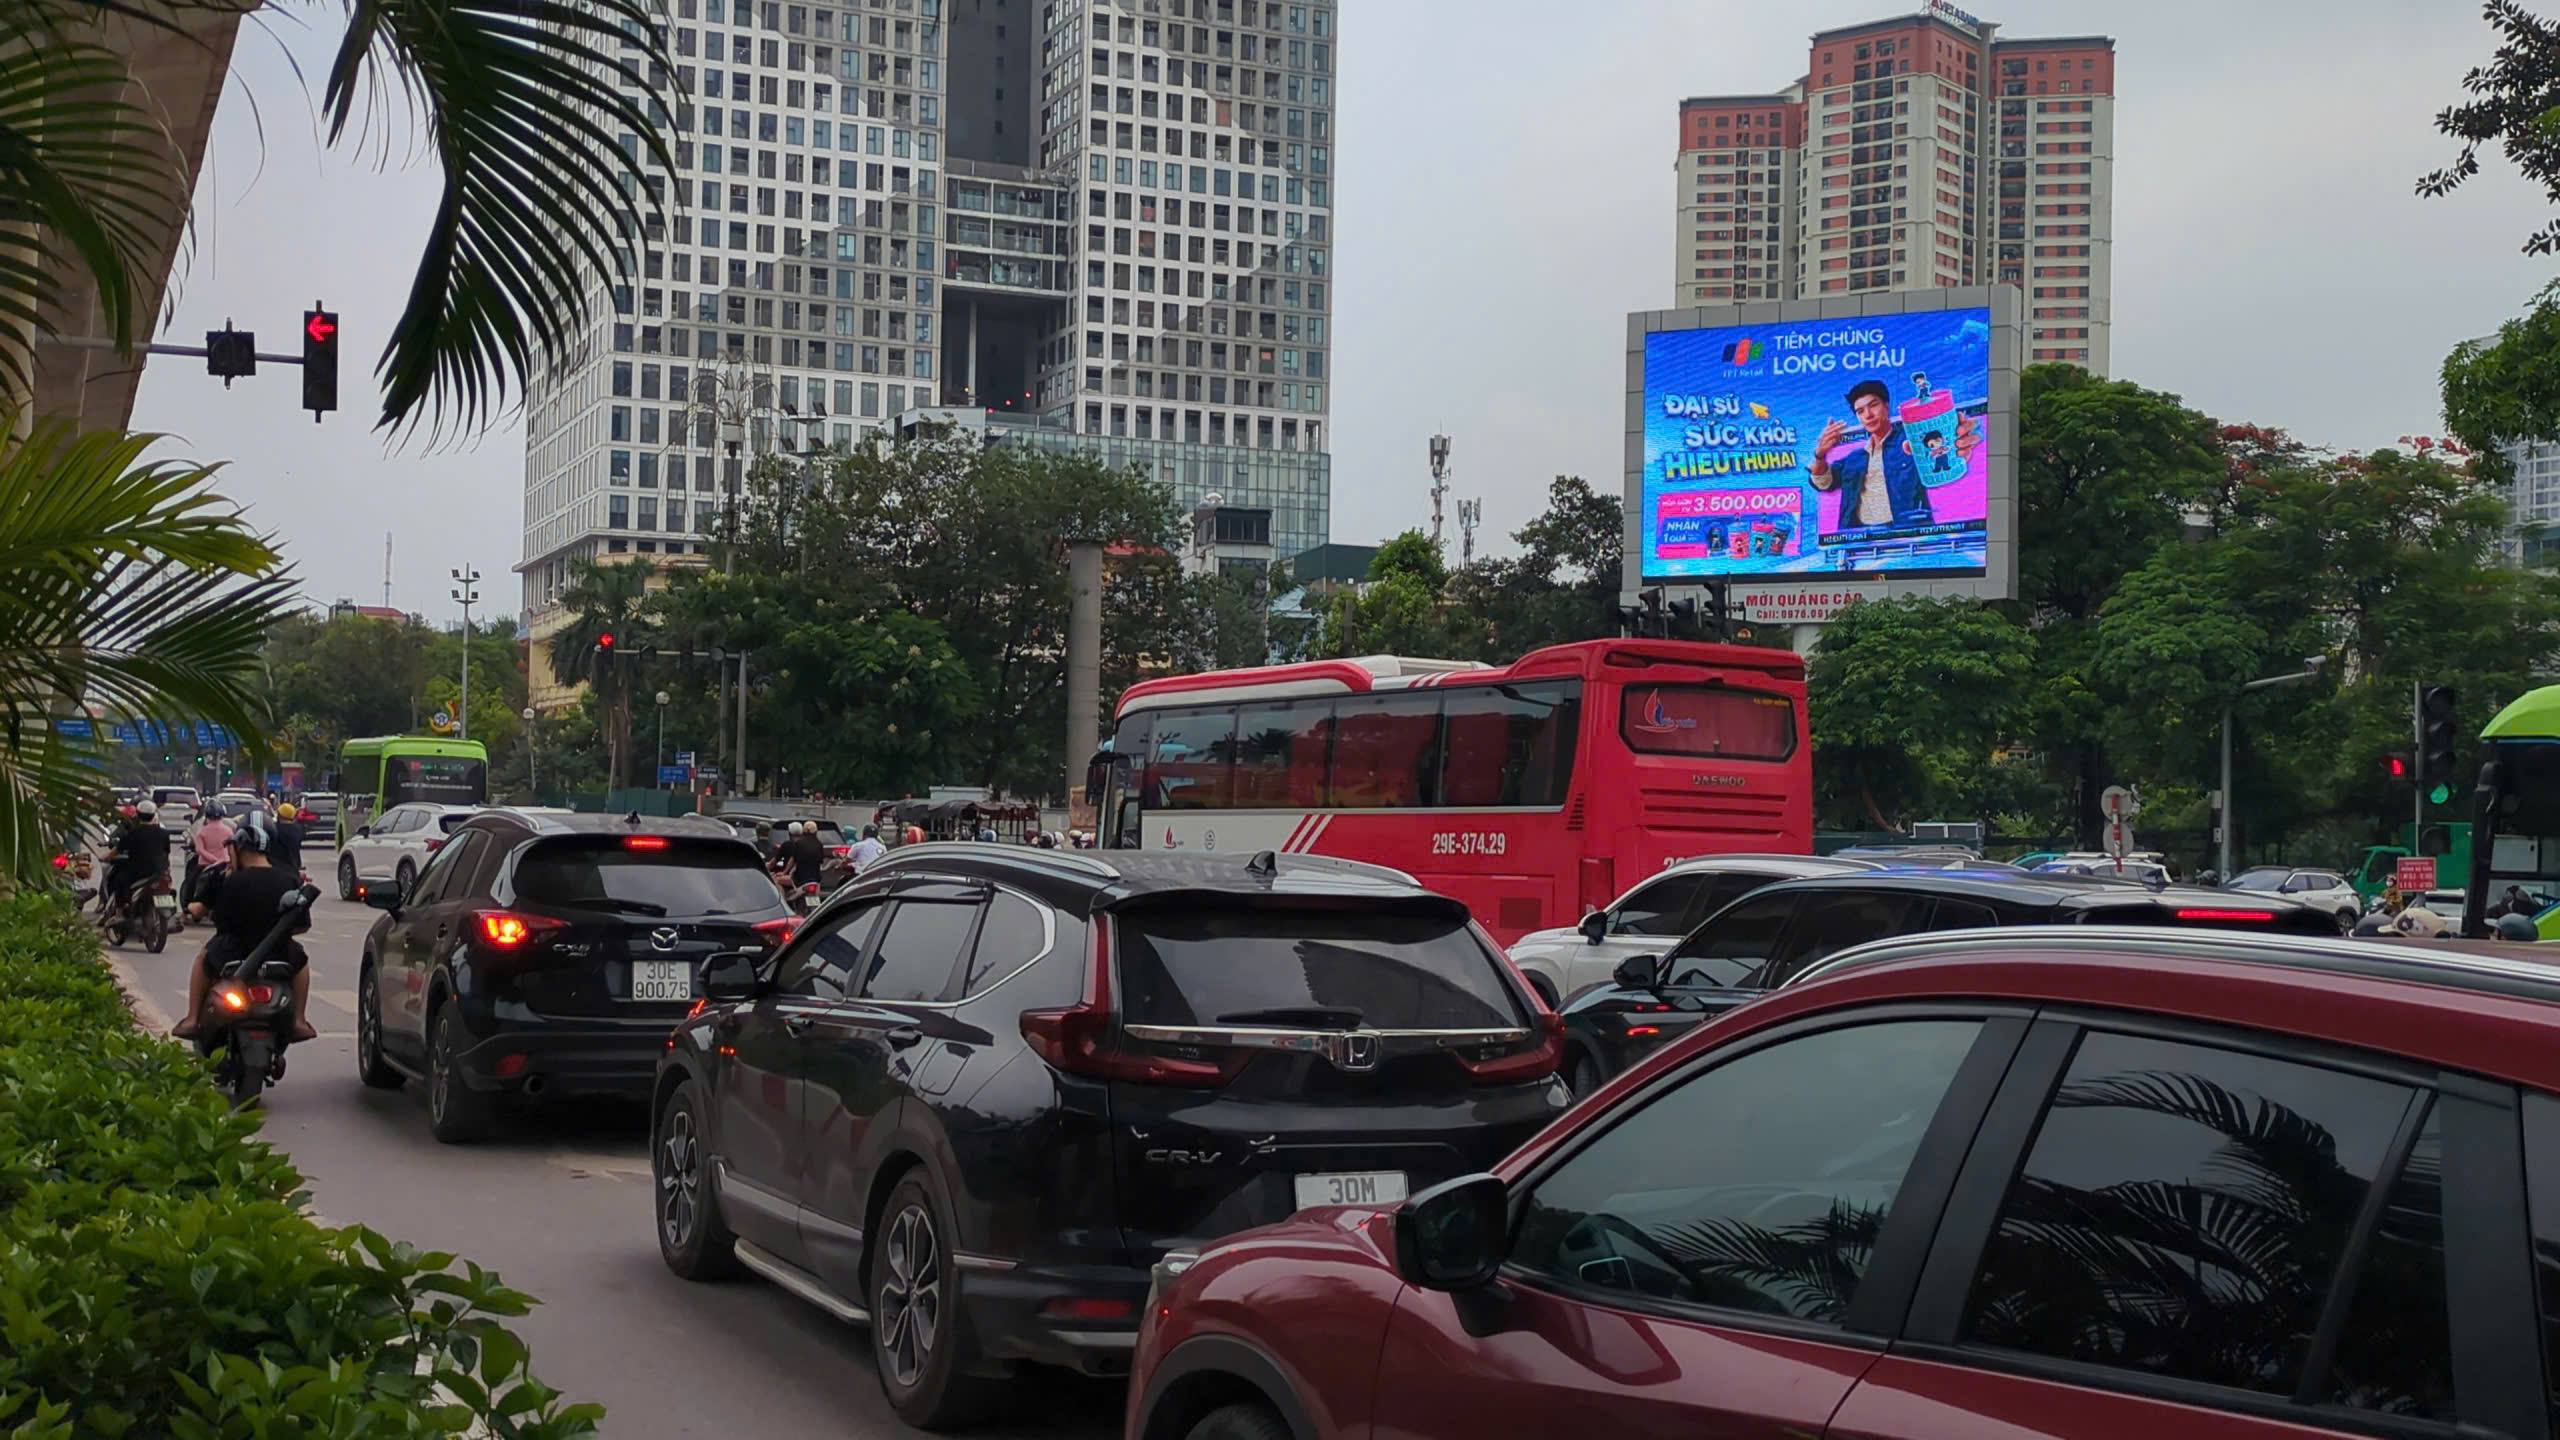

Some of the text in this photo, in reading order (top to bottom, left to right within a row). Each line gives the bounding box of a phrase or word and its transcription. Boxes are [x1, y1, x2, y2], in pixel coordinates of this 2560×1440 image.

[1774, 331, 1813, 349] TIÊM
[1773, 345, 1906, 375] LONG CHÂU
[1664, 394, 1709, 419] ĐẠI
[1685, 420, 1740, 447] SỨC
[1664, 450, 1797, 478] HIEUTHUHAI
[1692, 774, 1746, 787] DAEWOO
[1432, 832, 1505, 854] 29E-374.29
[647, 962, 677, 980] 30E
[635, 981, 689, 999] 900.75
[1146, 1150, 1222, 1163] CR-V
[1328, 1177, 1376, 1204] 30M
